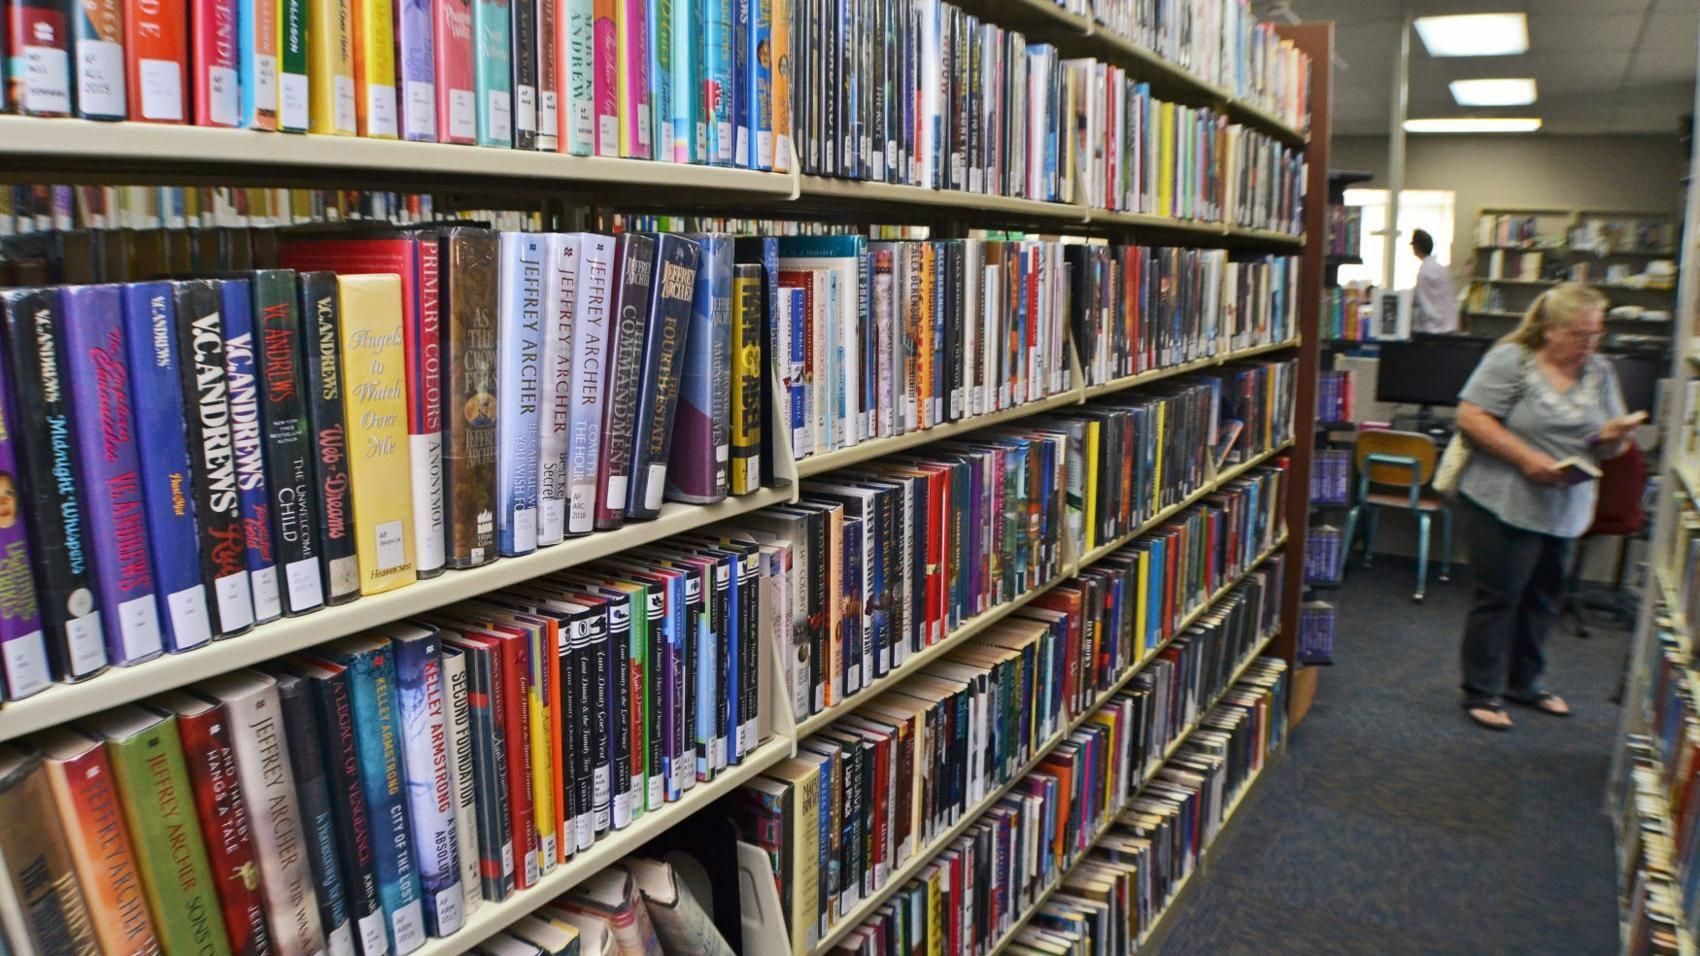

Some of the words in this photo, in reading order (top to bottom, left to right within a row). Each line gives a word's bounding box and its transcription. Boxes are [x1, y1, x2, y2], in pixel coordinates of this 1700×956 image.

[571, 10, 584, 101] ANDREW
[423, 240, 441, 334] PRIMARY
[519, 260, 540, 334] JEFFREY
[557, 268, 575, 345] JEFFREY
[586, 258, 607, 327] JEFFREY
[265, 328, 296, 403] ANDREWS
[520, 339, 538, 416] ARCHER
[581, 331, 600, 406] ARCHER
[658, 316, 679, 387] FOURTH
[425, 342, 442, 430] COLORS
[552, 353, 570, 433] ARCHER
[607, 304, 638, 478] COMMANDMENT
[46, 415, 77, 494] Midnight
[318, 423, 343, 464] Web
[513, 433, 527, 461] YOU
[577, 419, 589, 442] THE
[650, 394, 671, 454] ESTATE
[293, 456, 304, 482] THE
[428, 440, 444, 533] ANONYMOU
[513, 465, 527, 497] WISH
[541, 463, 558, 500] Secret
[572, 445, 587, 482] HOUR
[61, 496, 87, 575] Whispers
[278, 487, 299, 542] CHILD
[295, 485, 314, 559] UNWELCOME
[325, 473, 348, 540] Dreams
[111, 502, 150, 591] ANDREWS
[374, 676, 390, 722] KELLEY
[423, 659, 442, 717] KELLEY
[450, 673, 468, 728] SECOND
[206, 750, 226, 804] HANGS
[221, 746, 236, 777] AND
[250, 716, 284, 787] JEFFREY
[380, 725, 399, 795] ARMSTRONG
[429, 724, 453, 814] ARMSTRONG
[454, 729, 475, 809] FOUNDATION
[156, 753, 190, 819] JEFFREY
[217, 805, 228, 816] A
[390, 804, 404, 832] CITY
[166, 822, 199, 893] ARCHER
[221, 819, 240, 855] TALE
[264, 795, 301, 871] ARCHER
[394, 835, 406, 852] OF
[396, 854, 409, 874] THE
[109, 864, 147, 943] ARCHER
[186, 895, 212, 946] SONS
[287, 879, 303, 907] THIS
[400, 875, 413, 903] LOST
[294, 908, 311, 938] WAS
